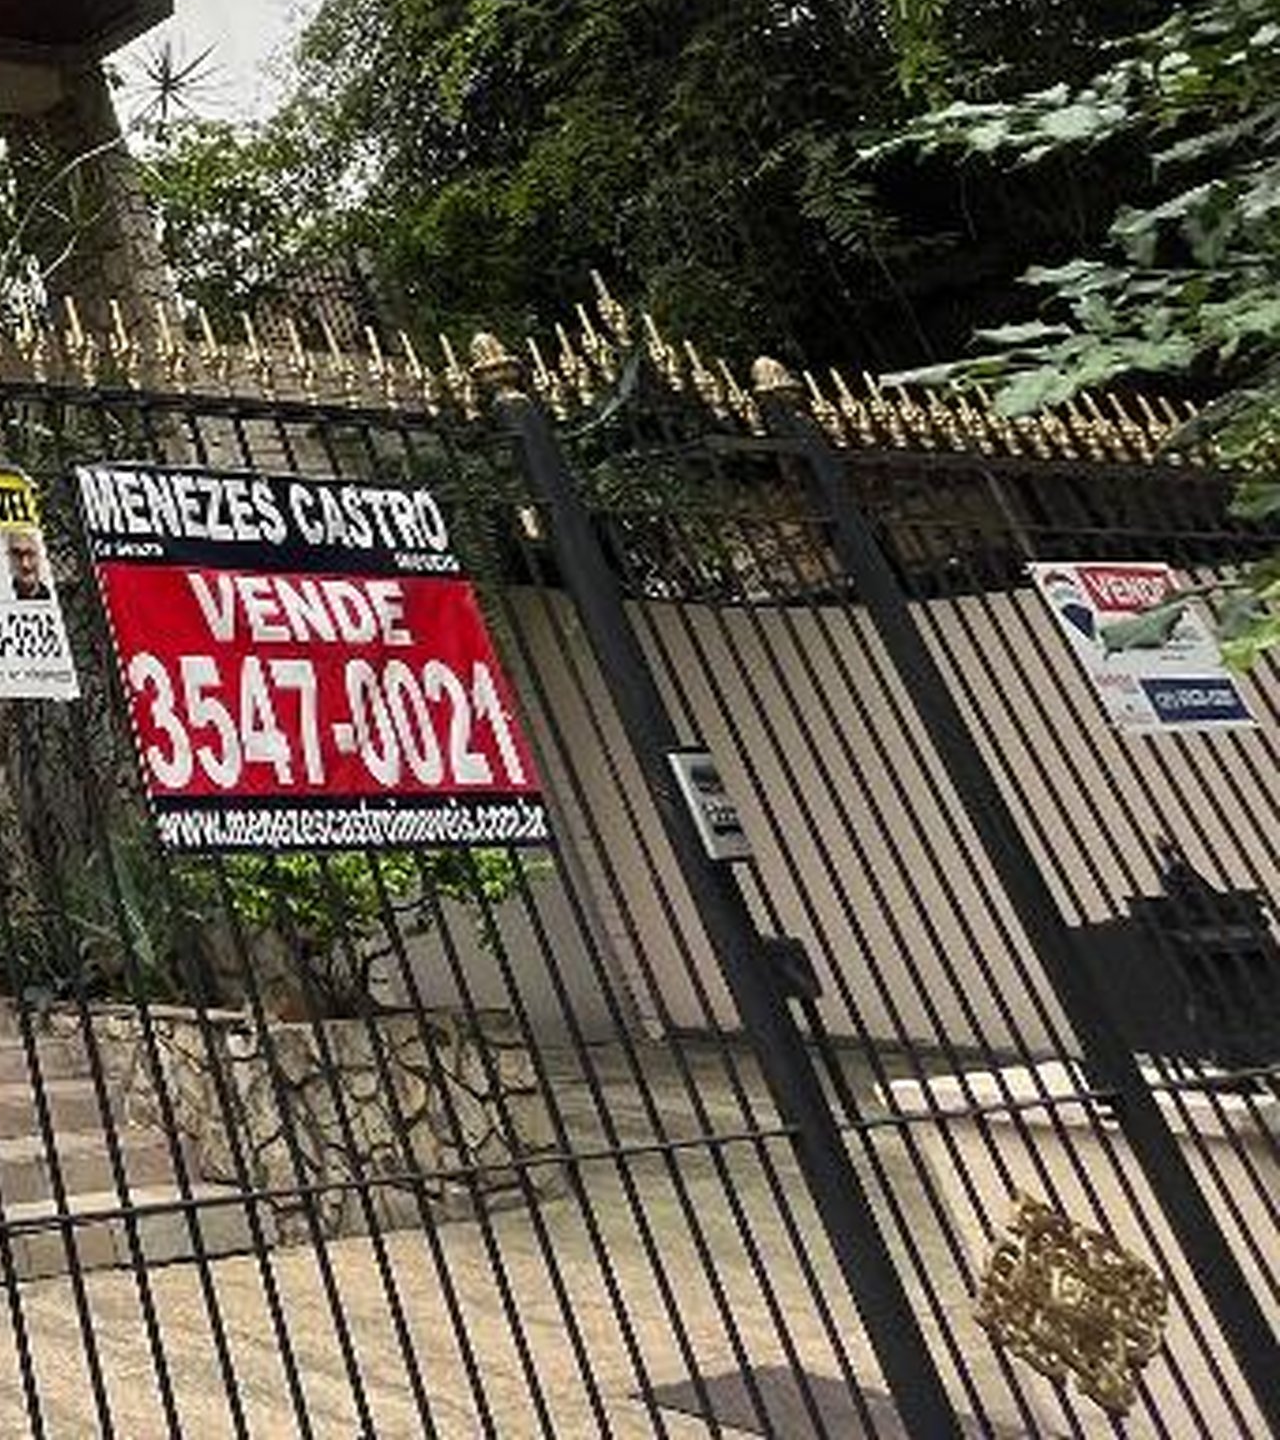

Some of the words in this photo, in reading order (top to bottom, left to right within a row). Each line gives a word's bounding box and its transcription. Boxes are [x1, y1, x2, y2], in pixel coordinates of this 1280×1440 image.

[76, 466, 286, 544] MENEZES
[289, 483, 448, 552] CASTRO
[188, 572, 412, 646] VENDE
[126, 651, 527, 789] 3547-0021
